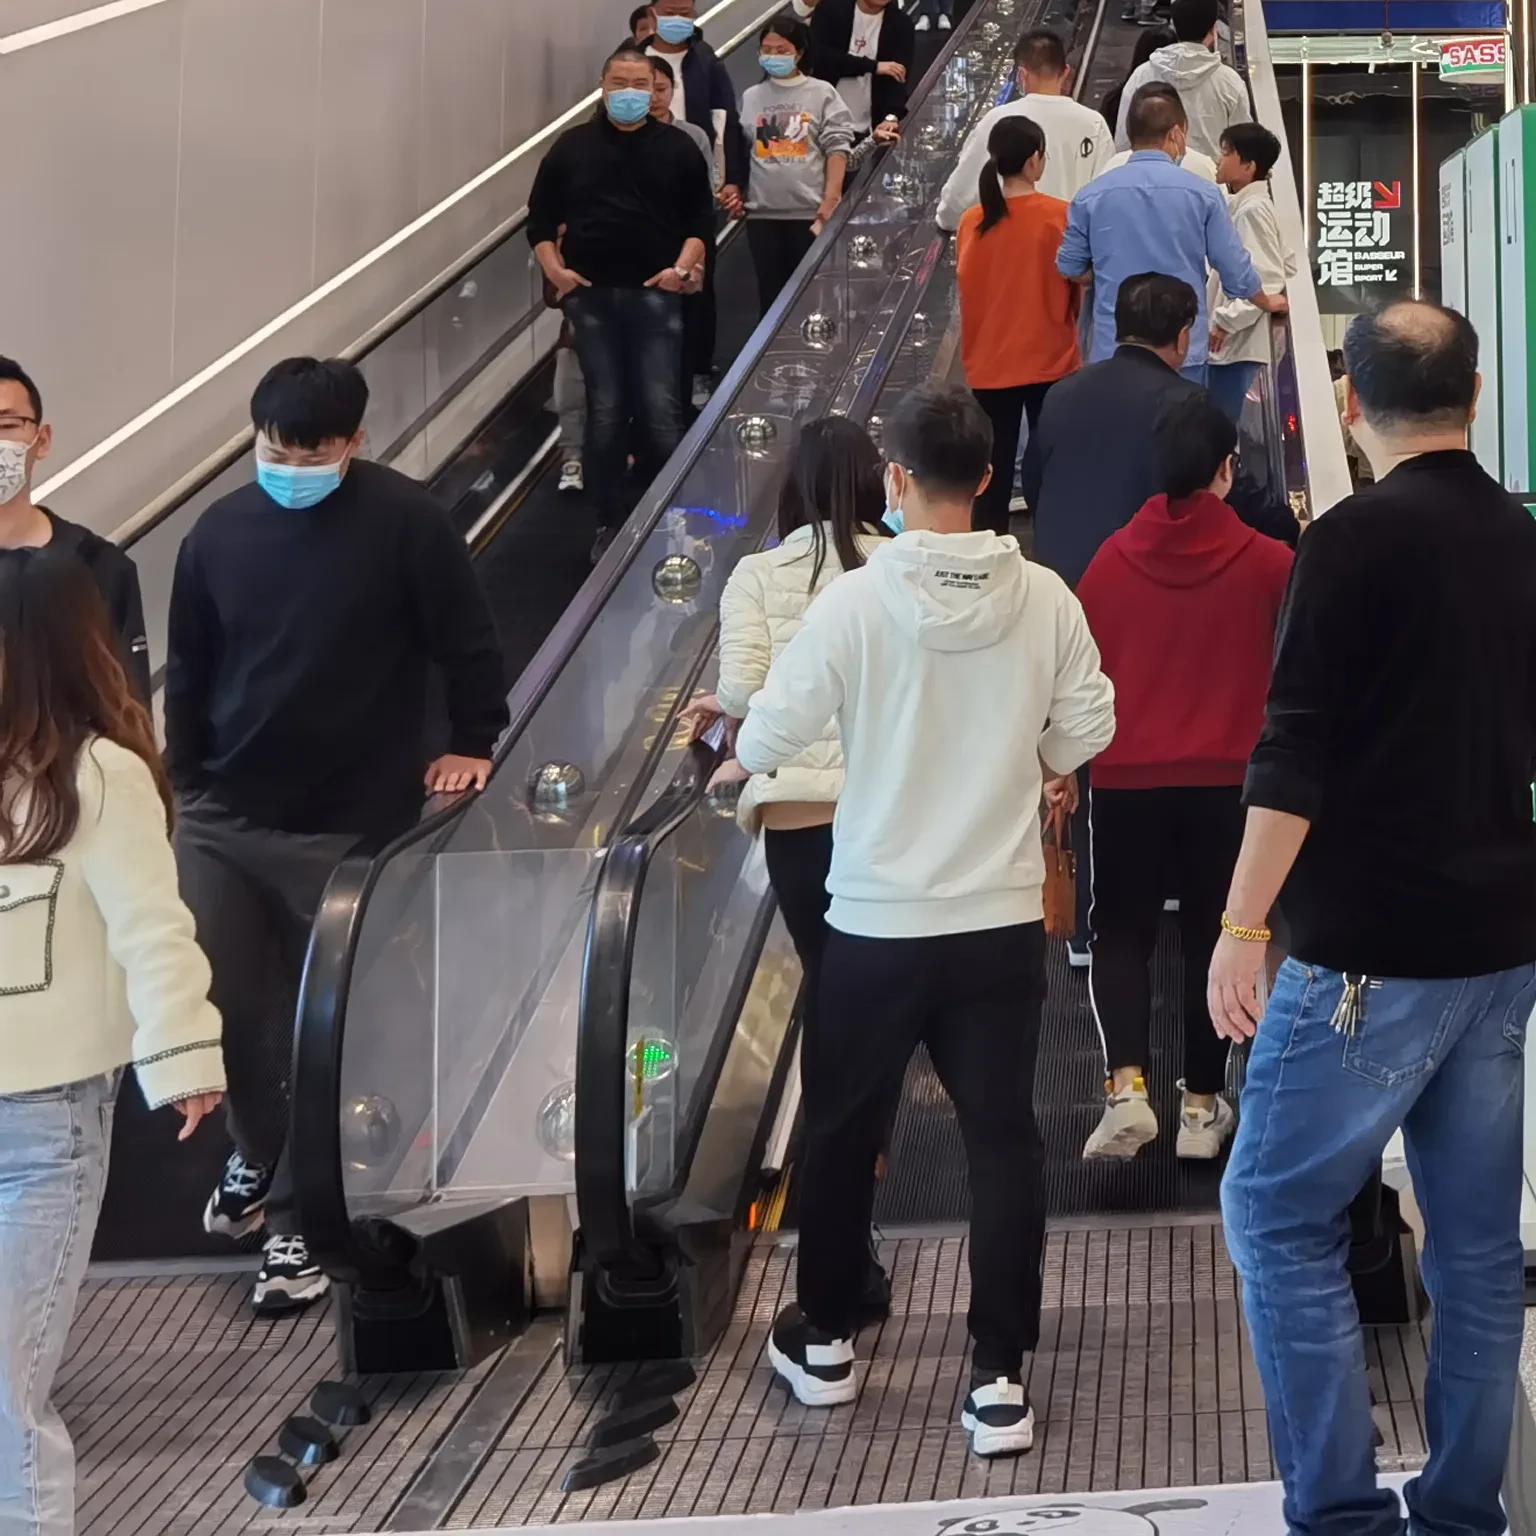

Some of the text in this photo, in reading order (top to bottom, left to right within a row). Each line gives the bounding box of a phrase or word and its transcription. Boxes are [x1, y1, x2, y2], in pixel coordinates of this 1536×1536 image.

[1317, 181, 1372, 209] 超级
[1317, 211, 1390, 248] 运动
[1354, 250, 1405, 261] SASSEUR
[1317, 249, 1353, 286] 馆
[1354, 263, 1384, 271] SUPER
[1354, 273, 1384, 282] SPORT
